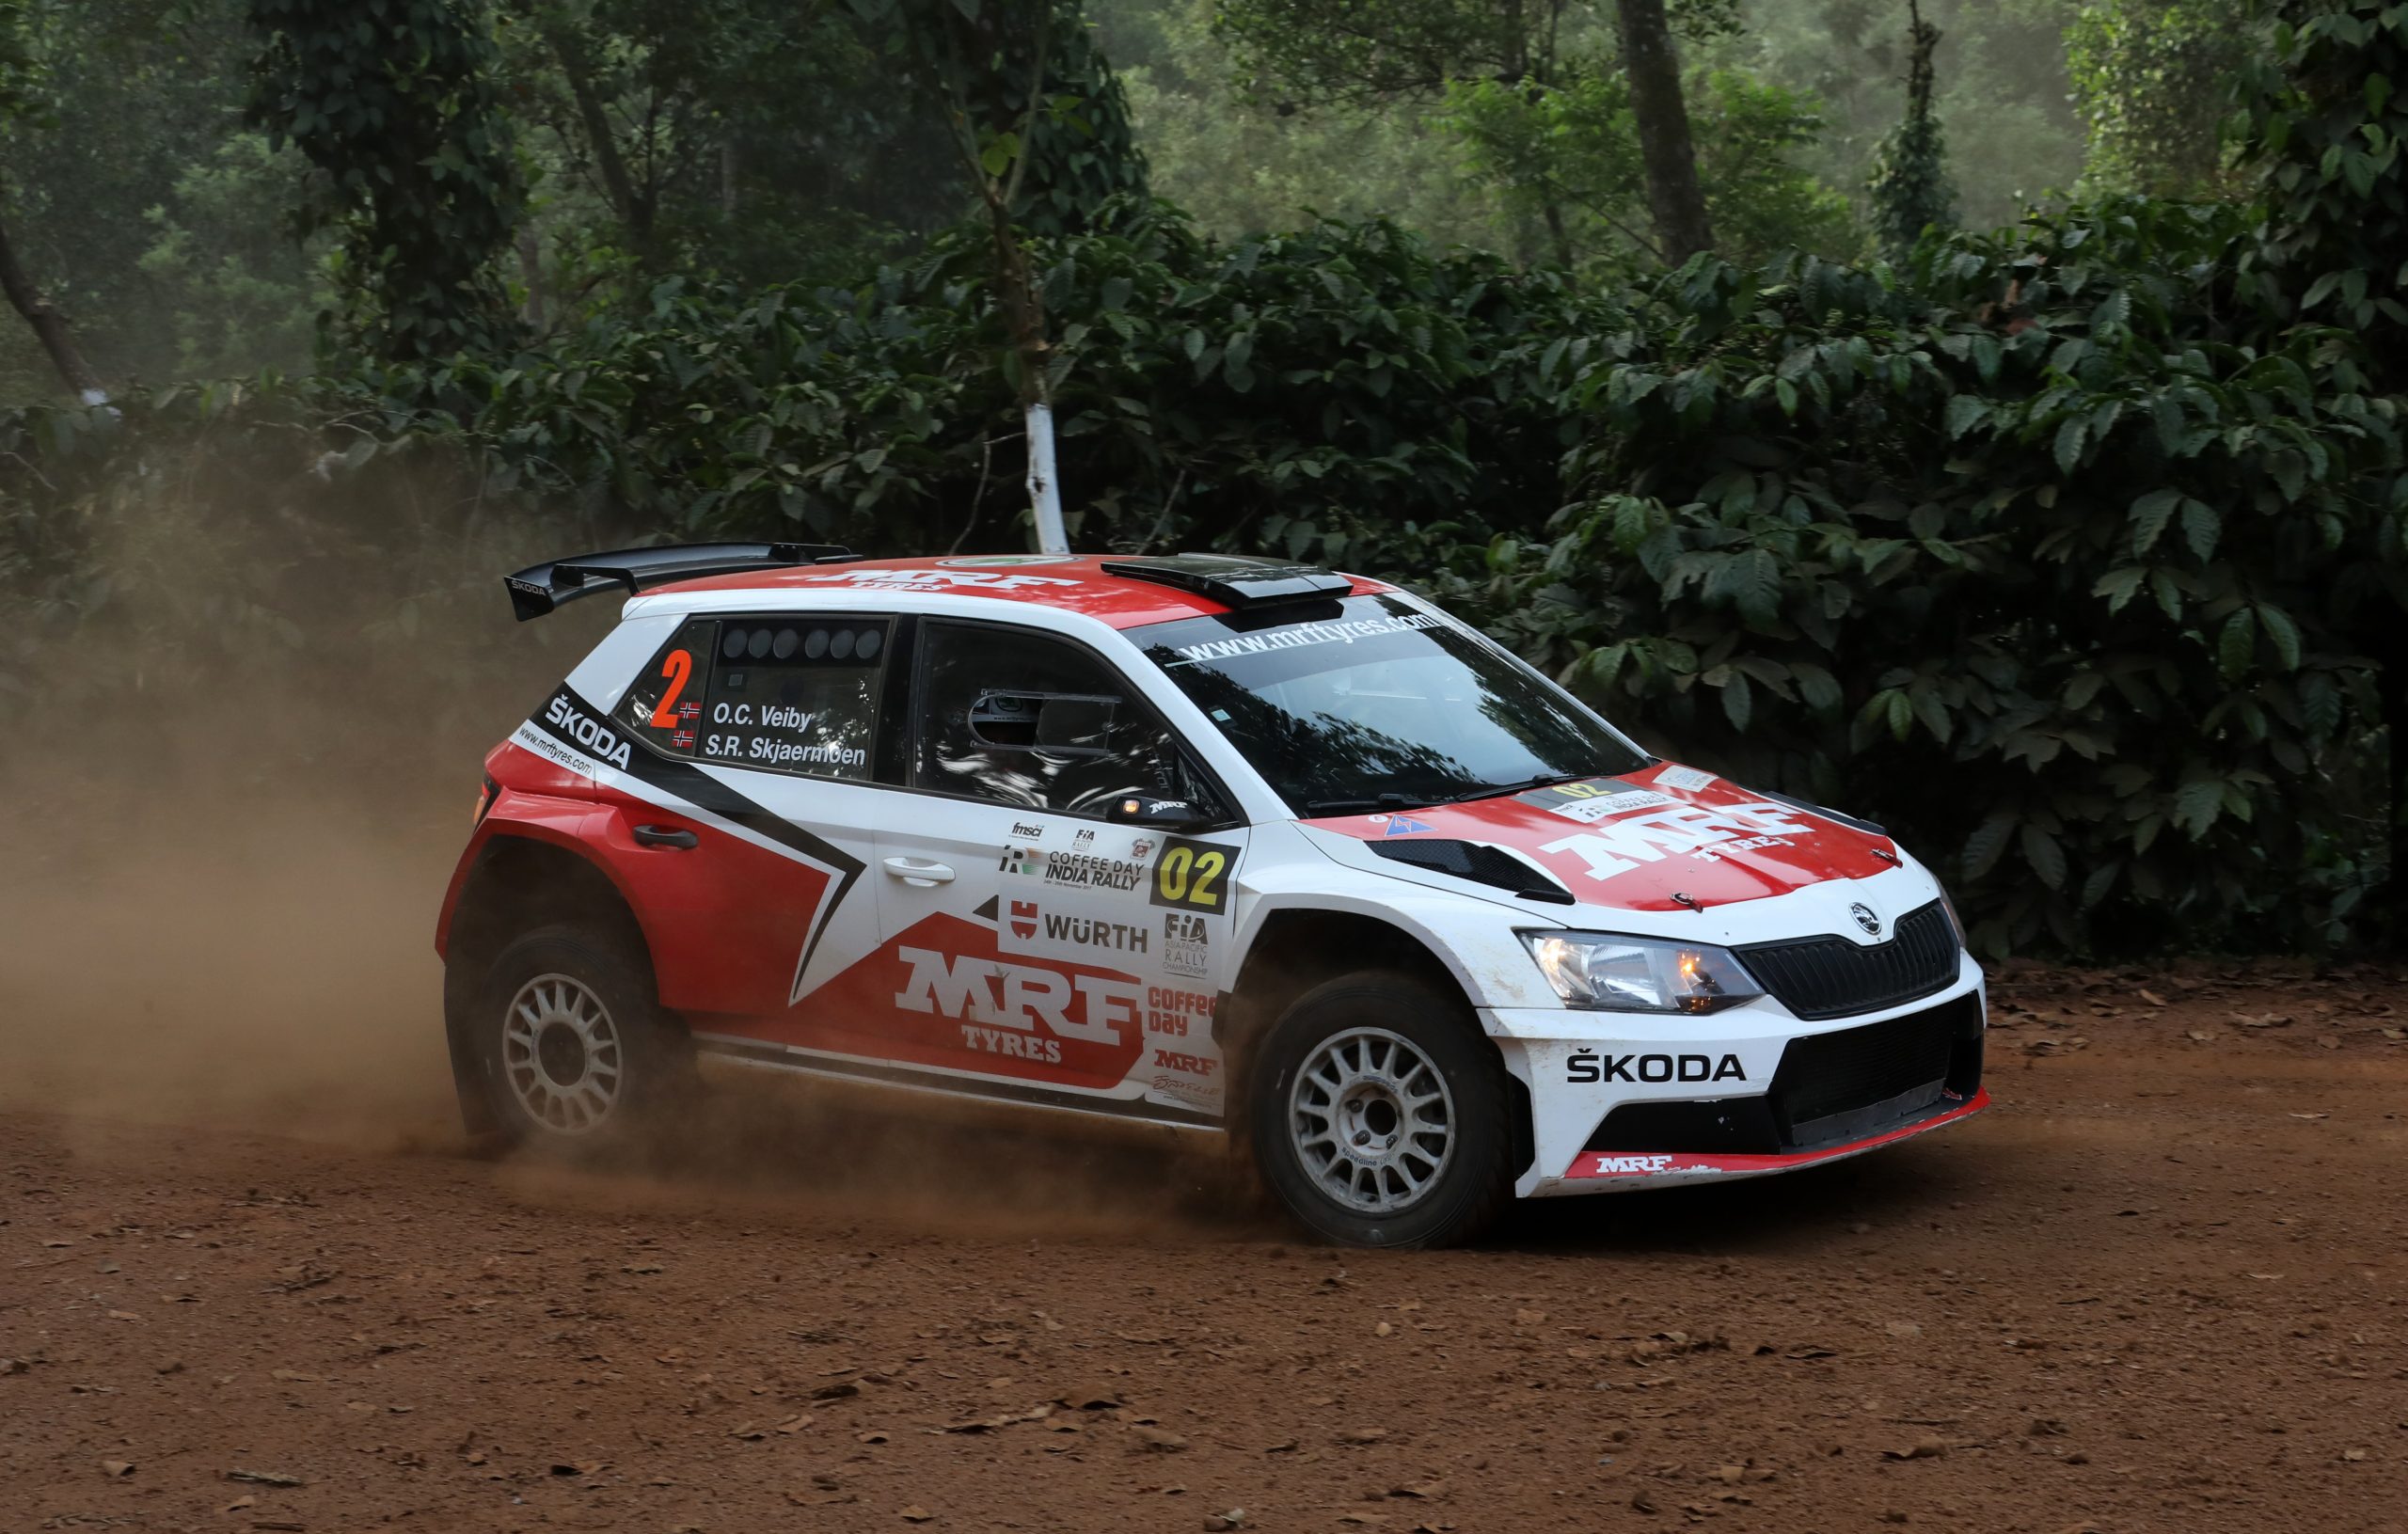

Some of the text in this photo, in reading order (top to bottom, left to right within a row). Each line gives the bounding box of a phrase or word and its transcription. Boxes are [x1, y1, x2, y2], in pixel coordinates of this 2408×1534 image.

[807, 569, 1084, 590] MRF
[851, 581, 943, 592] TYRES
[1177, 613, 1442, 661] www.mrftyres.com
[650, 649, 692, 728] 2
[546, 693, 631, 770] ŠKODA
[713, 703, 813, 734] O.C. Veiby
[519, 726, 594, 775] www.mrftyres.com
[705, 734, 865, 766] S.R. Skjaermoen
[1552, 783, 1612, 799] 02
[1149, 800, 1188, 814] MRF
[1011, 822, 1044, 838] fmsci
[1537, 802, 1816, 881] MRF
[1689, 835, 1796, 863] TYRES
[1045, 863, 1141, 891] INDIA RALLY
[1050, 850, 1145, 877] COFFEE DAY
[1159, 846, 1225, 906] 02
[1164, 948, 1207, 966] RALLY
[895, 945, 1141, 1046] MRF
[961, 1024, 1062, 1064] TYRES
[1154, 1048, 1219, 1076] MRF
[1566, 1048, 1747, 1083] ŠKODA
[1341, 1147, 1378, 1166] speedline
[1596, 1155, 1672, 1173] MRF
